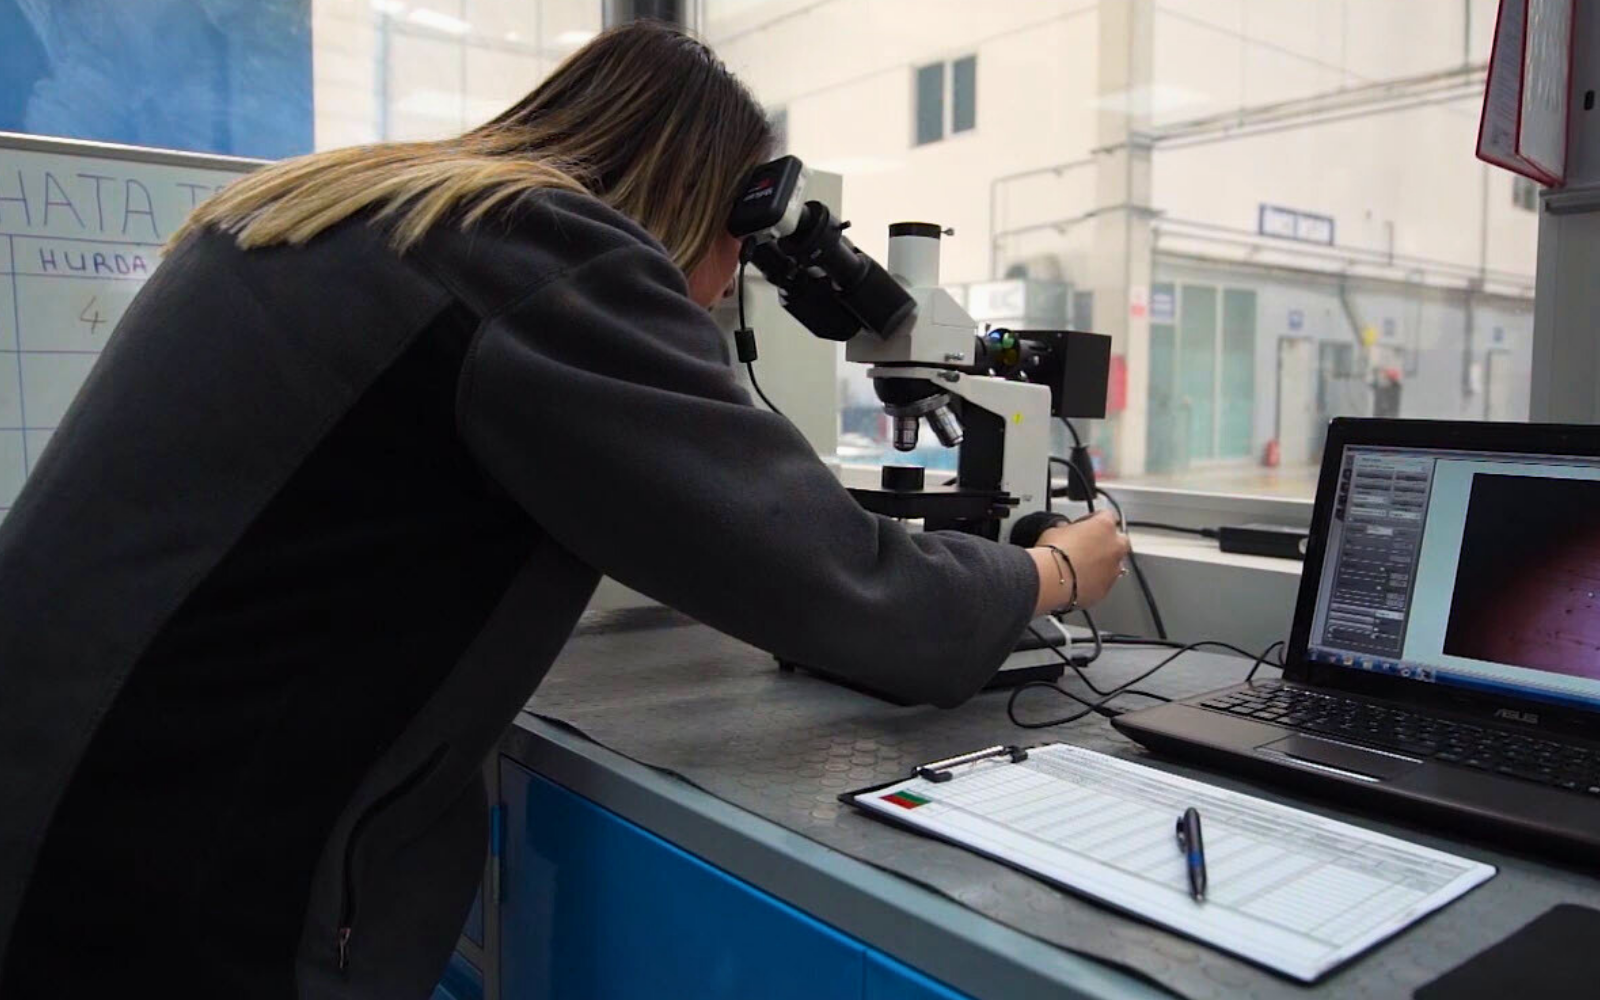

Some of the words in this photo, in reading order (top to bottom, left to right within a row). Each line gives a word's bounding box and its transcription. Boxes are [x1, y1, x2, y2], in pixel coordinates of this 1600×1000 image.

[0, 170, 160, 239] HATA
[40, 248, 147, 275] HURDA
[80, 296, 107, 334] 4
[1494, 708, 1539, 724] ASUS
